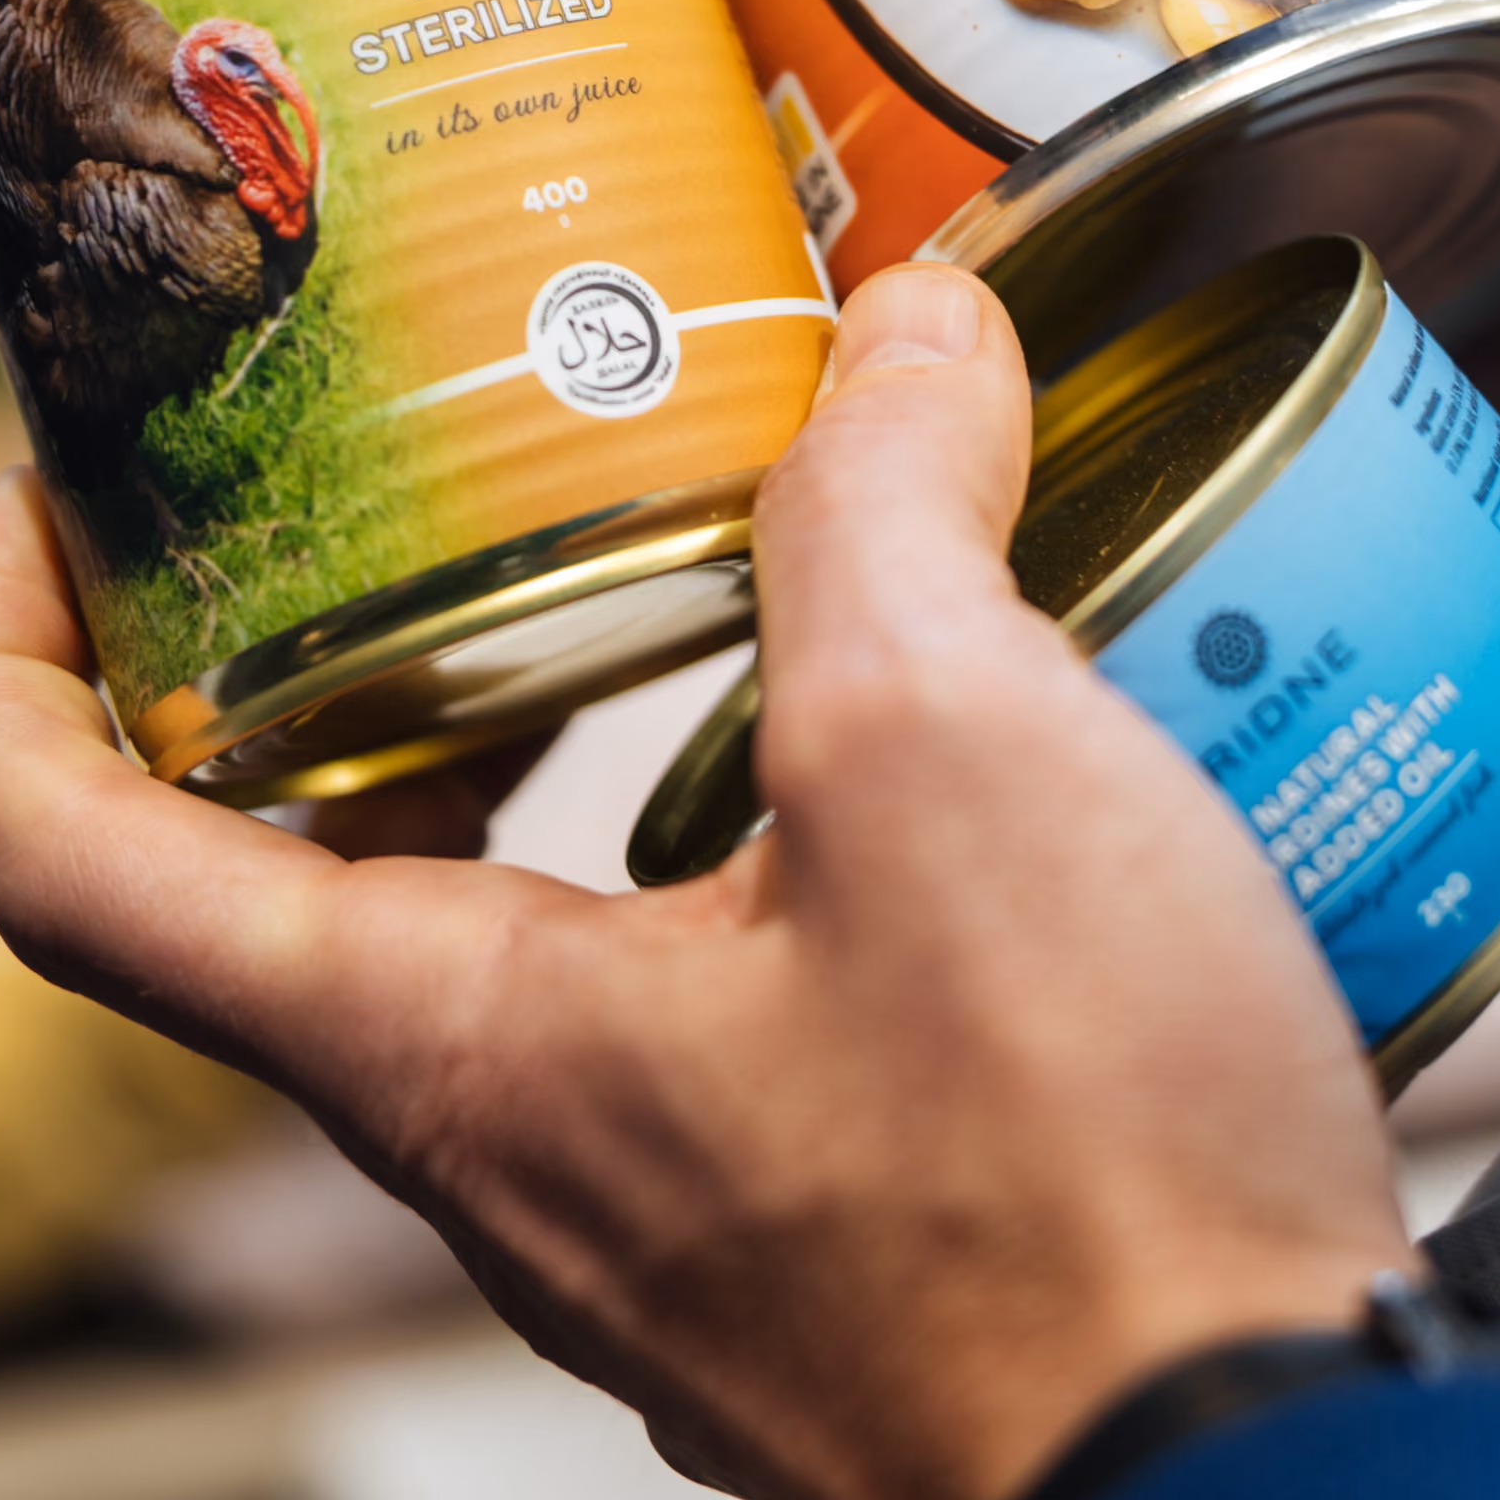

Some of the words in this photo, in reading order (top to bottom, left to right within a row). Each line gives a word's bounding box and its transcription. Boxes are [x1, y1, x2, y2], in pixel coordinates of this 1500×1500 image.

[386, 129, 423, 155] in
[438, 103, 481, 140] its
[493, 93, 562, 124] own
[566, 75, 642, 124] juice
[522, 175, 589, 214] 400
[1200, 627, 1356, 781] RIDNE
[1250, 693, 1398, 836] NATURAL
[1265, 749, 1391, 871] RDINES
[1377, 672, 1461, 762] WITH
[1293, 787, 1405, 902] ADDED
[1397, 740, 1455, 798] OIL
